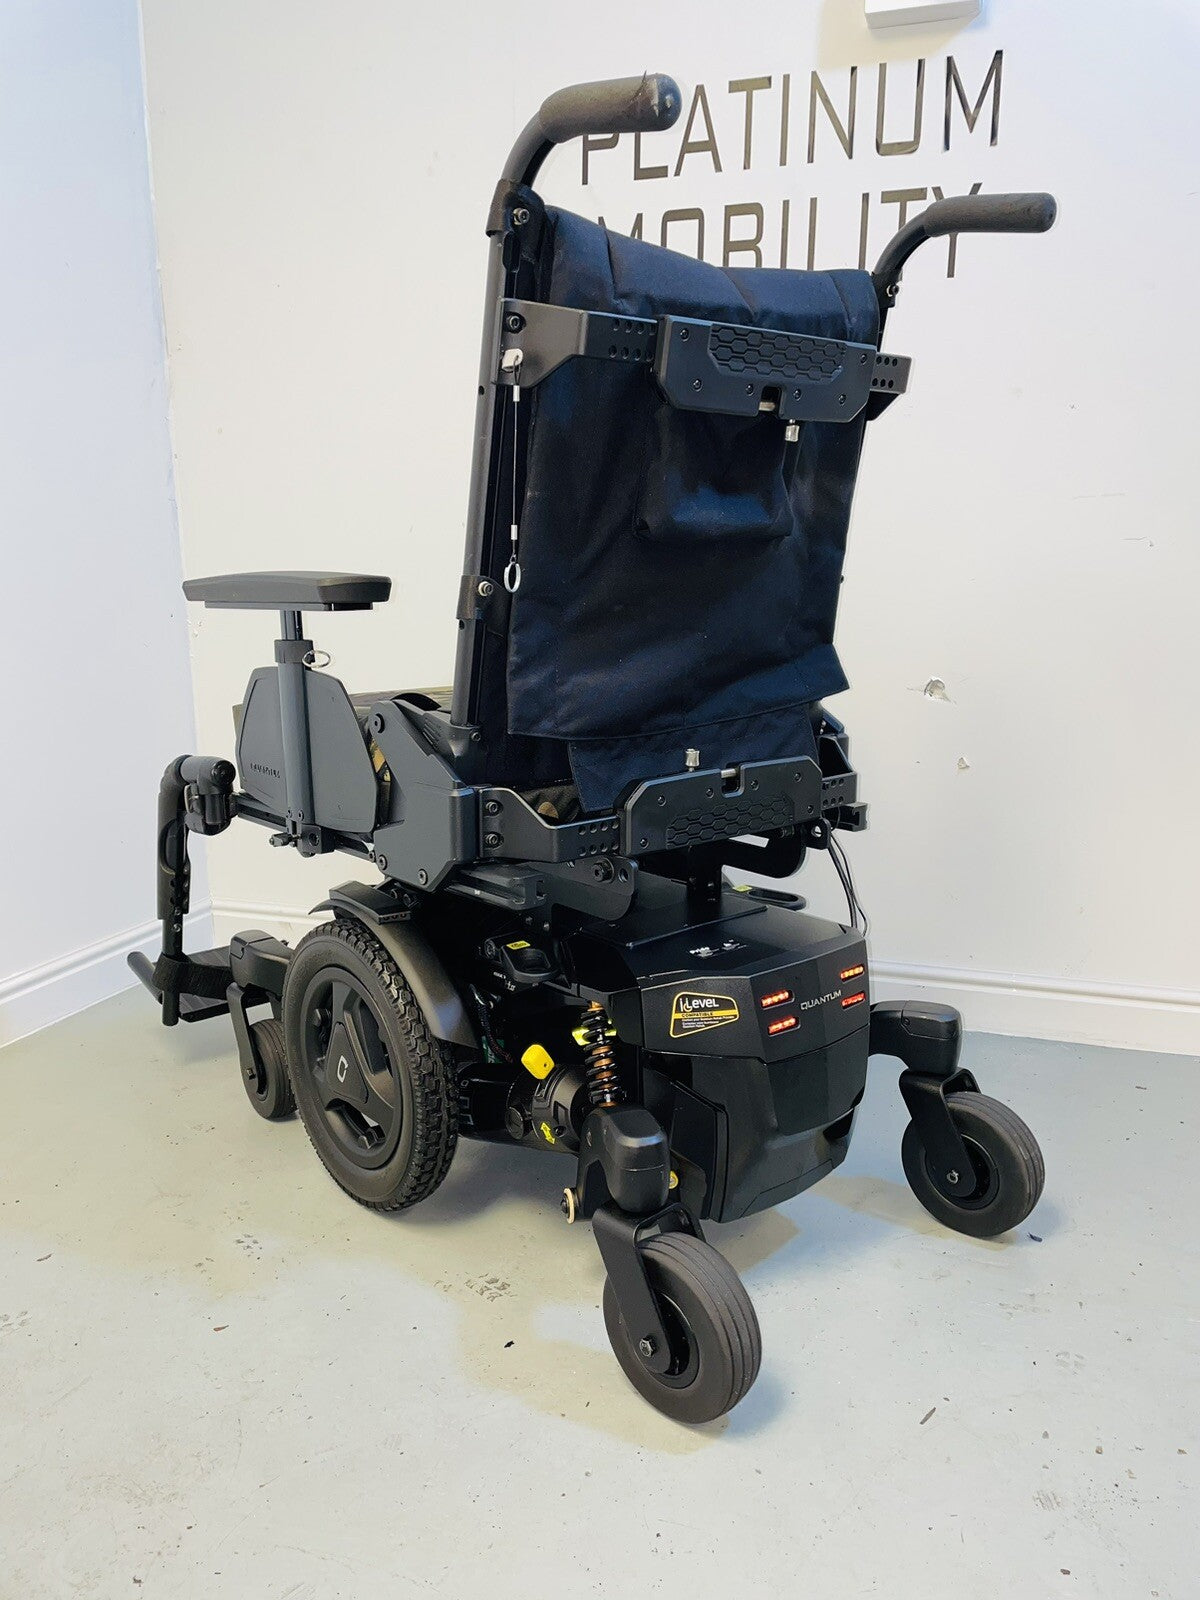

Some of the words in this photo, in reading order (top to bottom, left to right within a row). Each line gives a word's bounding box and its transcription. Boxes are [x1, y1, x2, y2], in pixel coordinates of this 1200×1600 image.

[581, 49, 1004, 186] PLATINUM
[597, 182, 983, 279] OBILITY
[800, 989, 842, 1010] QUANTUM
